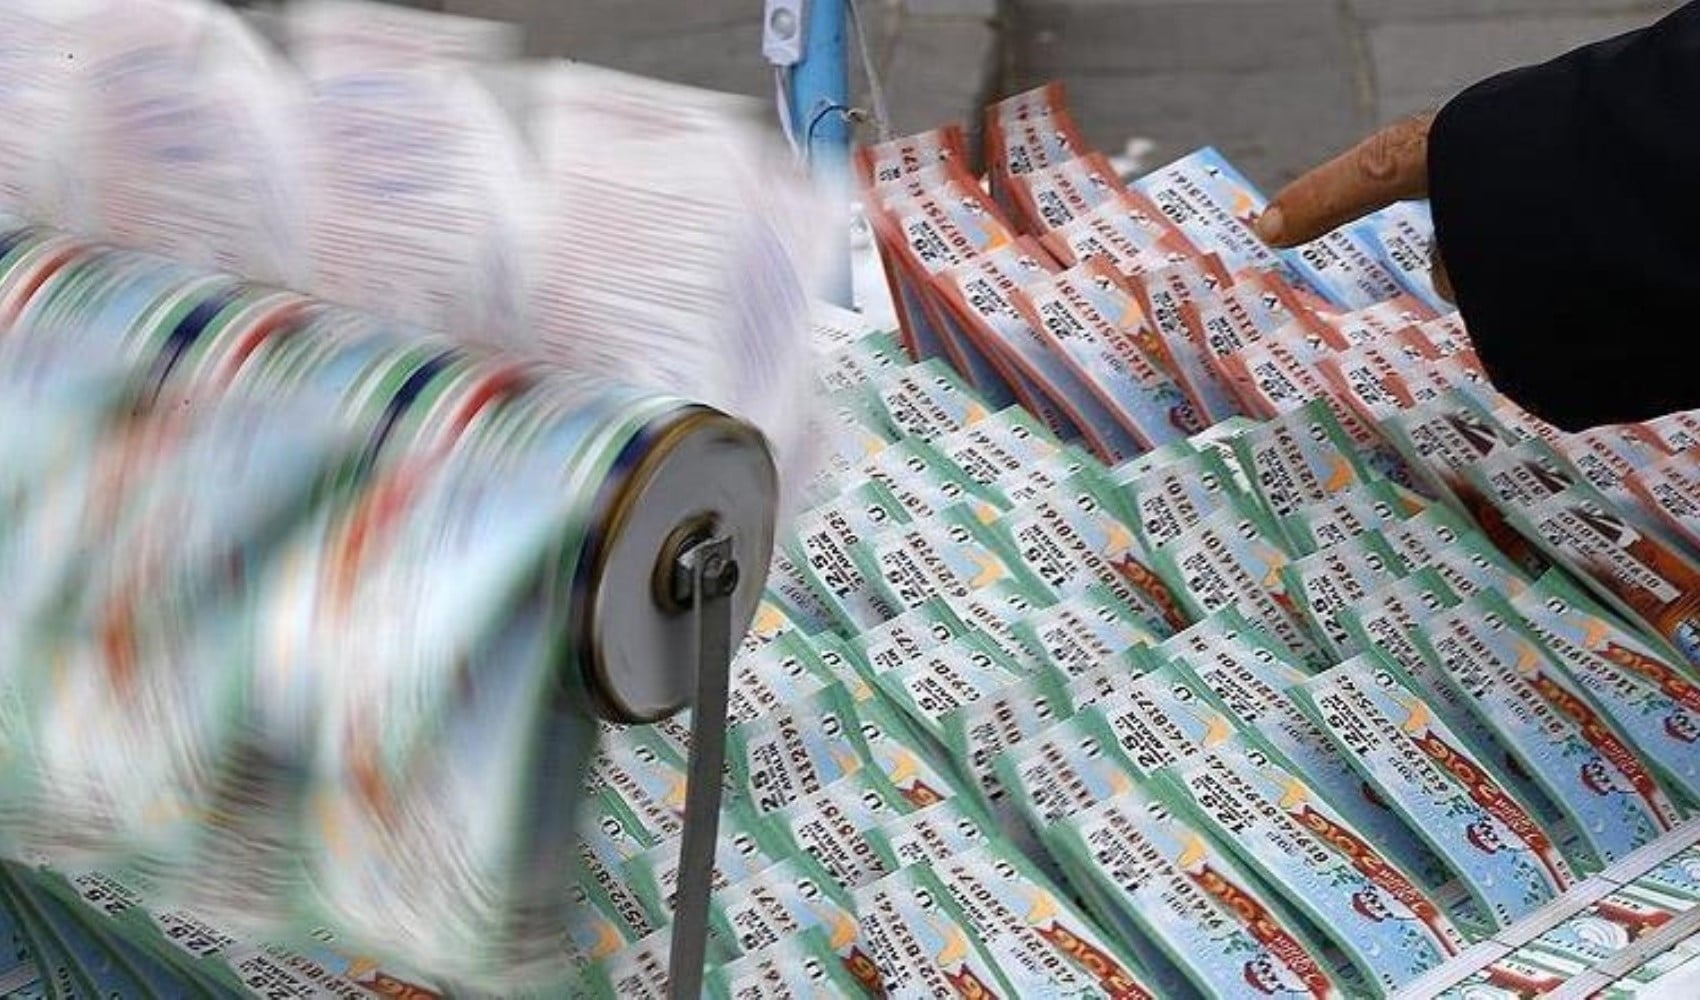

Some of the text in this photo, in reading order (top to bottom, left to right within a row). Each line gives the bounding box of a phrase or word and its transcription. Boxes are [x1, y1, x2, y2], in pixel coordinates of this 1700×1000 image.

[910, 234, 938, 264] 25
[1300, 244, 1328, 273] 50
[1043, 313, 1070, 341] 25
[1351, 379, 1381, 408] 25
[866, 503, 887, 525] U
[1076, 492, 1097, 513] U
[948, 523, 970, 545] U
[1029, 521, 1067, 561] ARALIK
[817, 529, 853, 571] ARALIK
[893, 547, 929, 587] ARALIK
[1193, 550, 1230, 592] ARALIK
[1364, 552, 1385, 573] U
[1545, 596, 1566, 616] U
[930, 622, 951, 643] U
[781, 657, 802, 678] U
[971, 650, 992, 671] U
[1212, 666, 1254, 702] ARALIK
[1373, 669, 1395, 691] U
[1172, 683, 1193, 704] U
[1328, 691, 1368, 733] ARALIK
[818, 714, 841, 737] U
[1124, 709, 1165, 751] ARALIK
[1246, 748, 1267, 769] U
[1201, 770, 1243, 810] ARALIK
[862, 791, 883, 813] U
[599, 816, 623, 840] U
[733, 834, 755, 857] U
[796, 877, 819, 900] U
[913, 888, 935, 911] U
[866, 911, 902, 963] ARALIK
